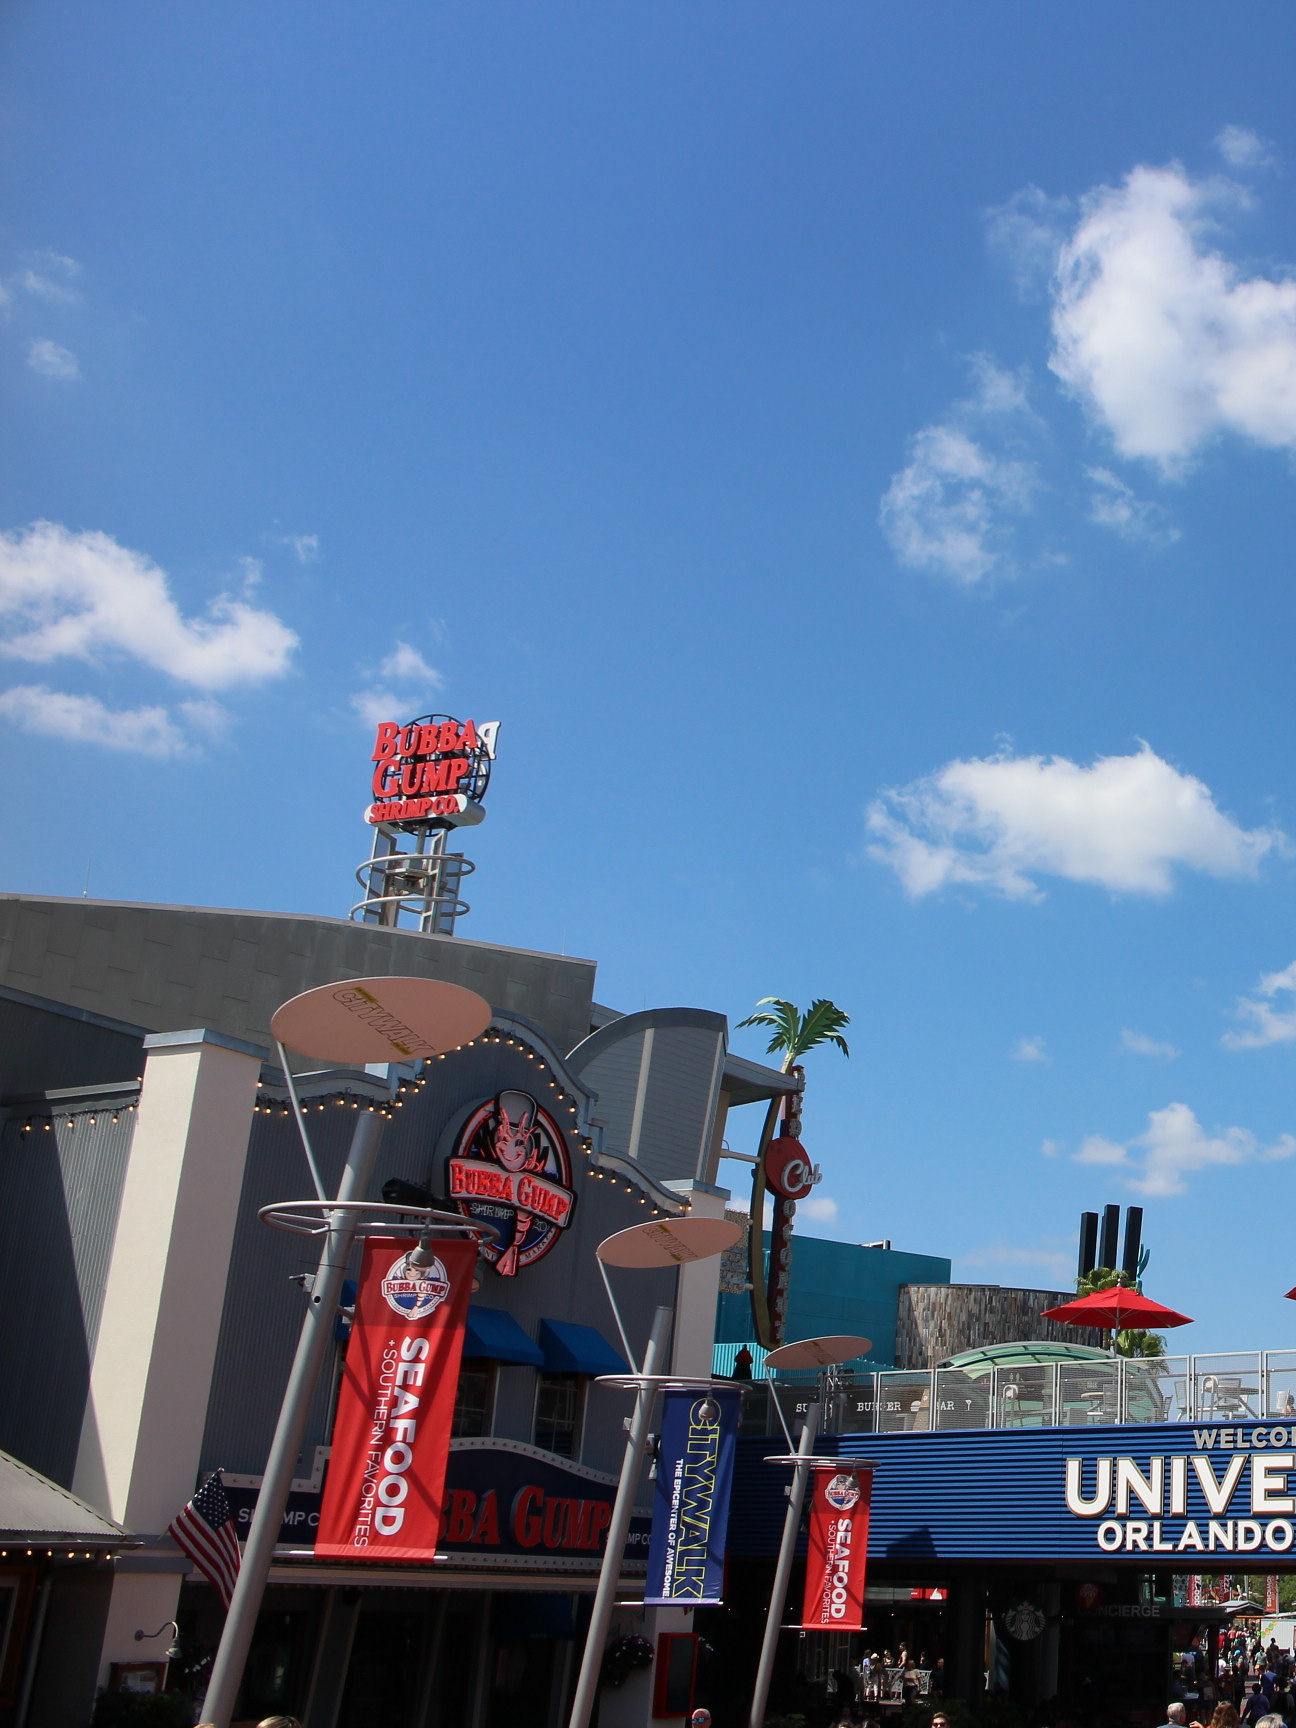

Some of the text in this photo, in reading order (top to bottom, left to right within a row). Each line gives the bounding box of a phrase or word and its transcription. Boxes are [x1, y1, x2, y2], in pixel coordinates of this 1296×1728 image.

[371, 719, 477, 761] BUBBA
[372, 758, 469, 798] GUMP
[369, 795, 460, 823] SHRIMP CO.
[451, 1162, 569, 1221] BUBBA GUMP
[781, 1159, 823, 1192] Club
[470, 1202, 514, 1219] SHRIMP
[386, 1280, 446, 1295] BUBBA GUMP
[354, 1349, 397, 1547] SOUTHERN FAVORITES
[374, 1336, 430, 1536] SEAFOOD
[510, 1485, 612, 1550] GUMP
[672, 1398, 721, 1599] CITYWALK
[663, 1458, 683, 1599] THE EPICENTER OF AWESOME.
[1097, 1518, 1294, 1553] ORLANDO
[820, 1525, 836, 1624] SOUTHERN FAVORITES
[831, 1518, 852, 1619] SEAFOOD
